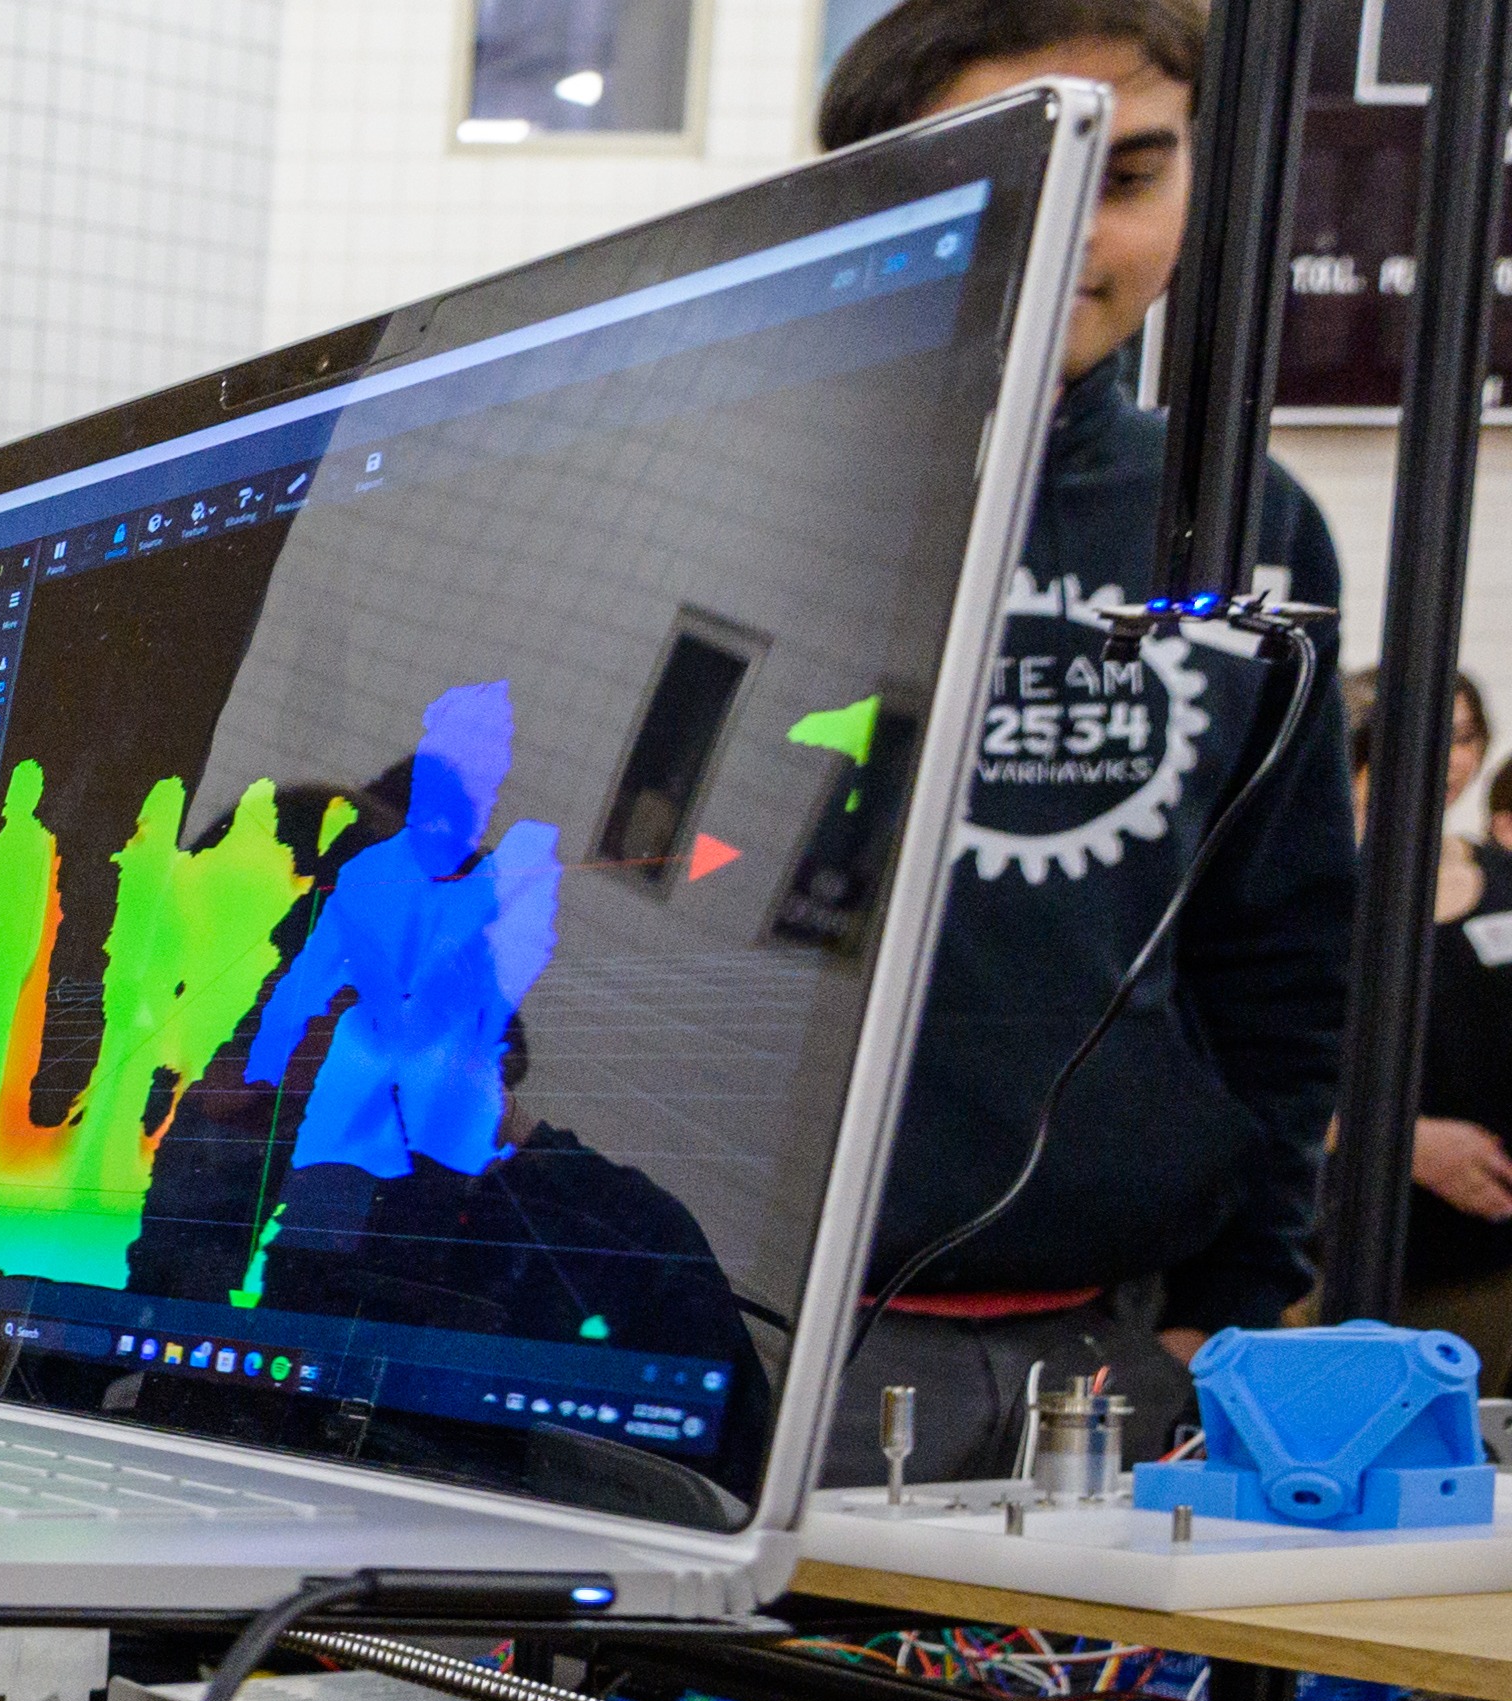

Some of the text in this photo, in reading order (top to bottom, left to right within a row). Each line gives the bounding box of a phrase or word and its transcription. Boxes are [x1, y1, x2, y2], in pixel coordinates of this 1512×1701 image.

[993, 655, 1144, 698] TEAM
[983, 703, 1151, 755] 2554
[976, 756, 1154, 784] WARHAWKS
